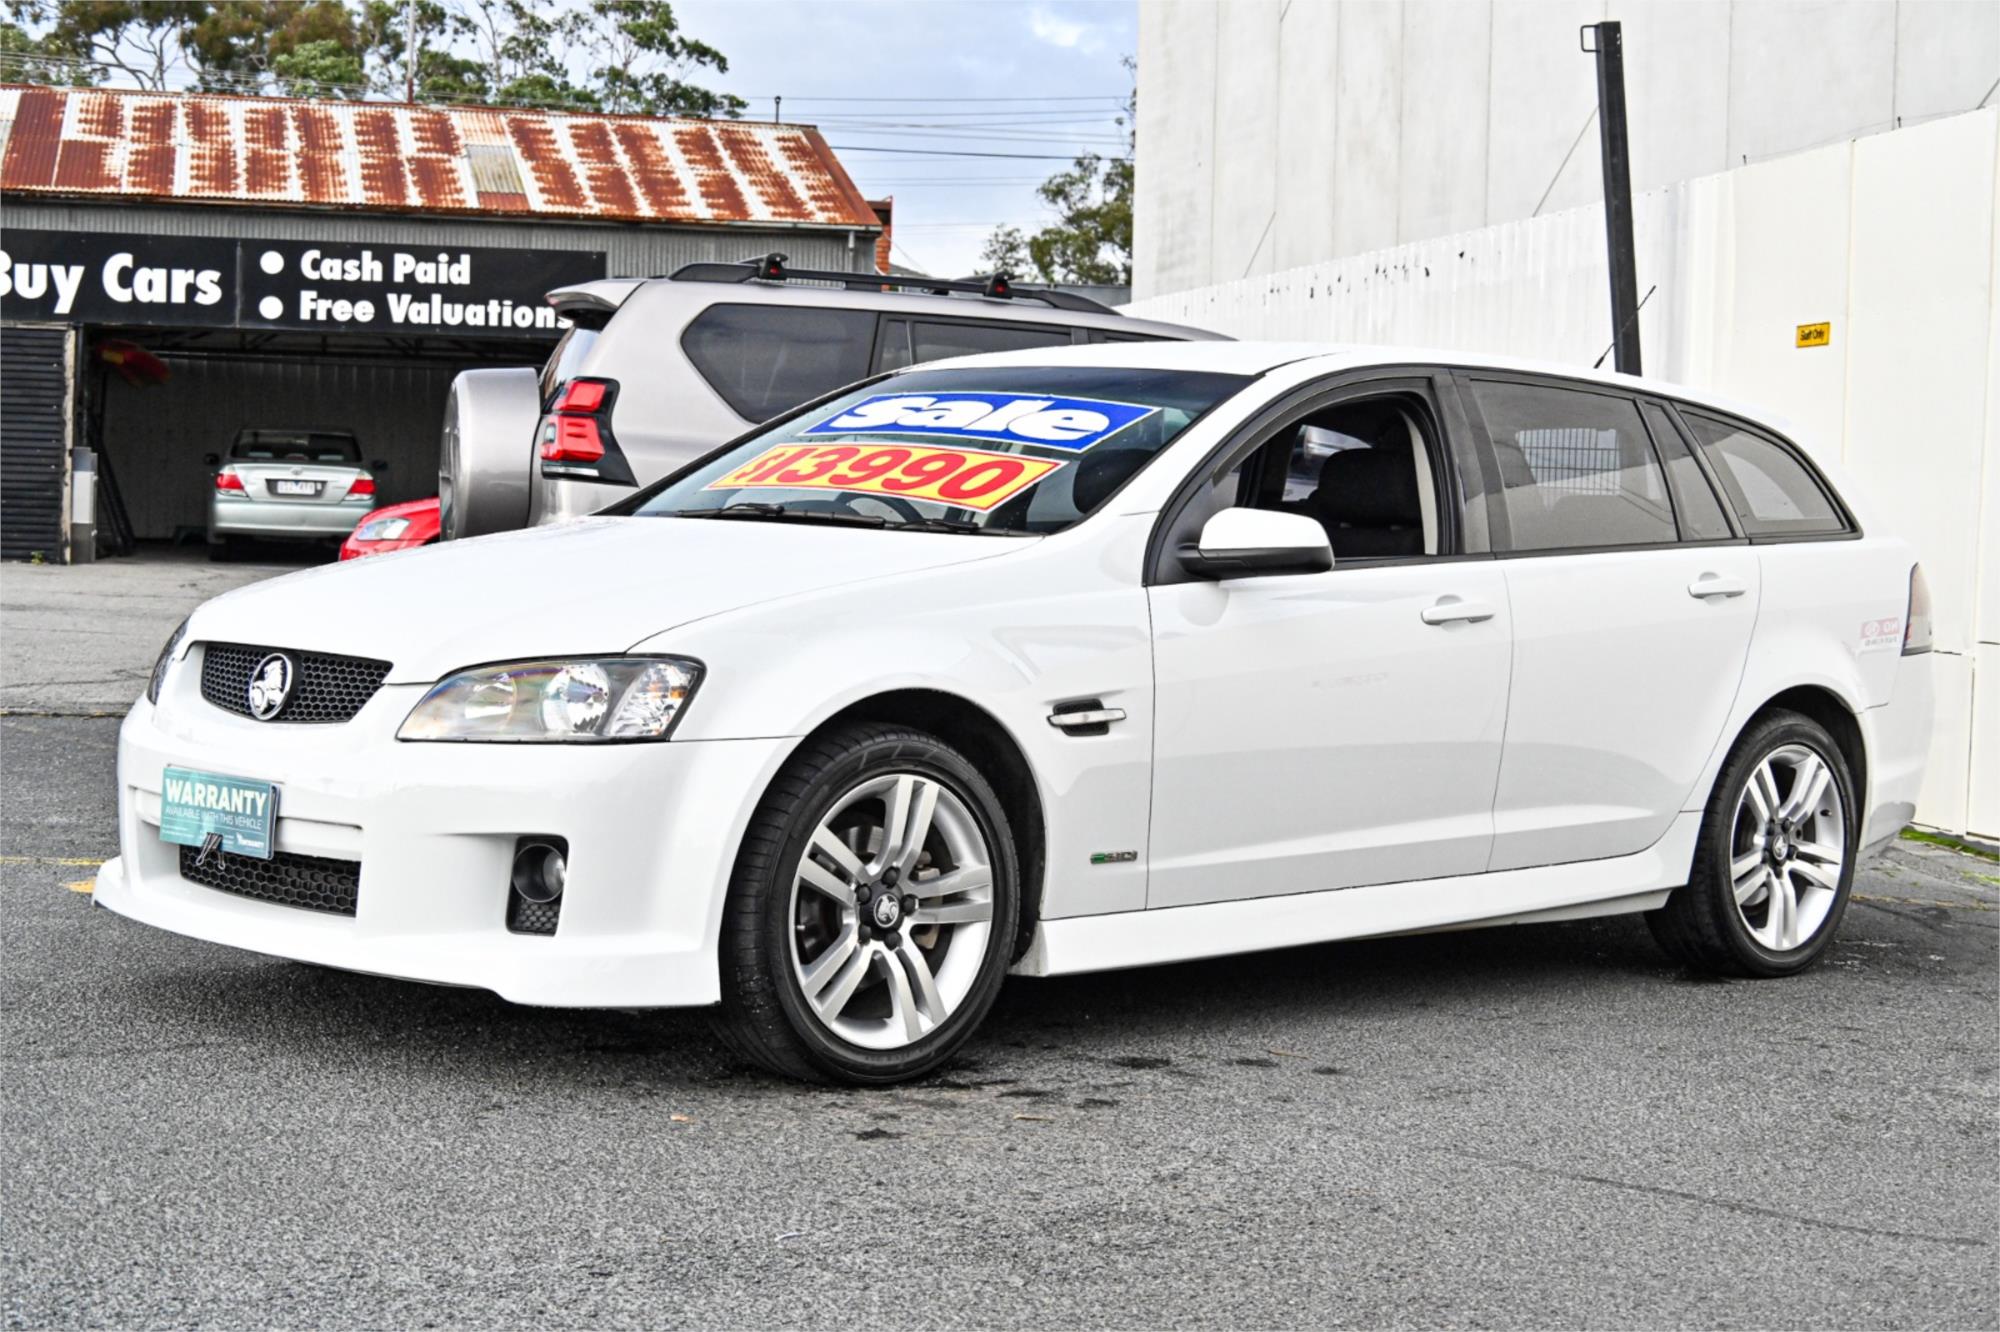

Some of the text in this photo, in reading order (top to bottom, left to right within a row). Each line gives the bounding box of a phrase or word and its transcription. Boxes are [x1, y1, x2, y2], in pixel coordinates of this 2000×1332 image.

[102, 253, 222, 305] Cars
[300, 250, 470, 284] Cash Paid
[300, 290, 375, 322] Free
[831, 397, 1110, 438] sale
[733, 446, 1024, 499] $13990
[166, 778, 267, 816] WARRANTY
